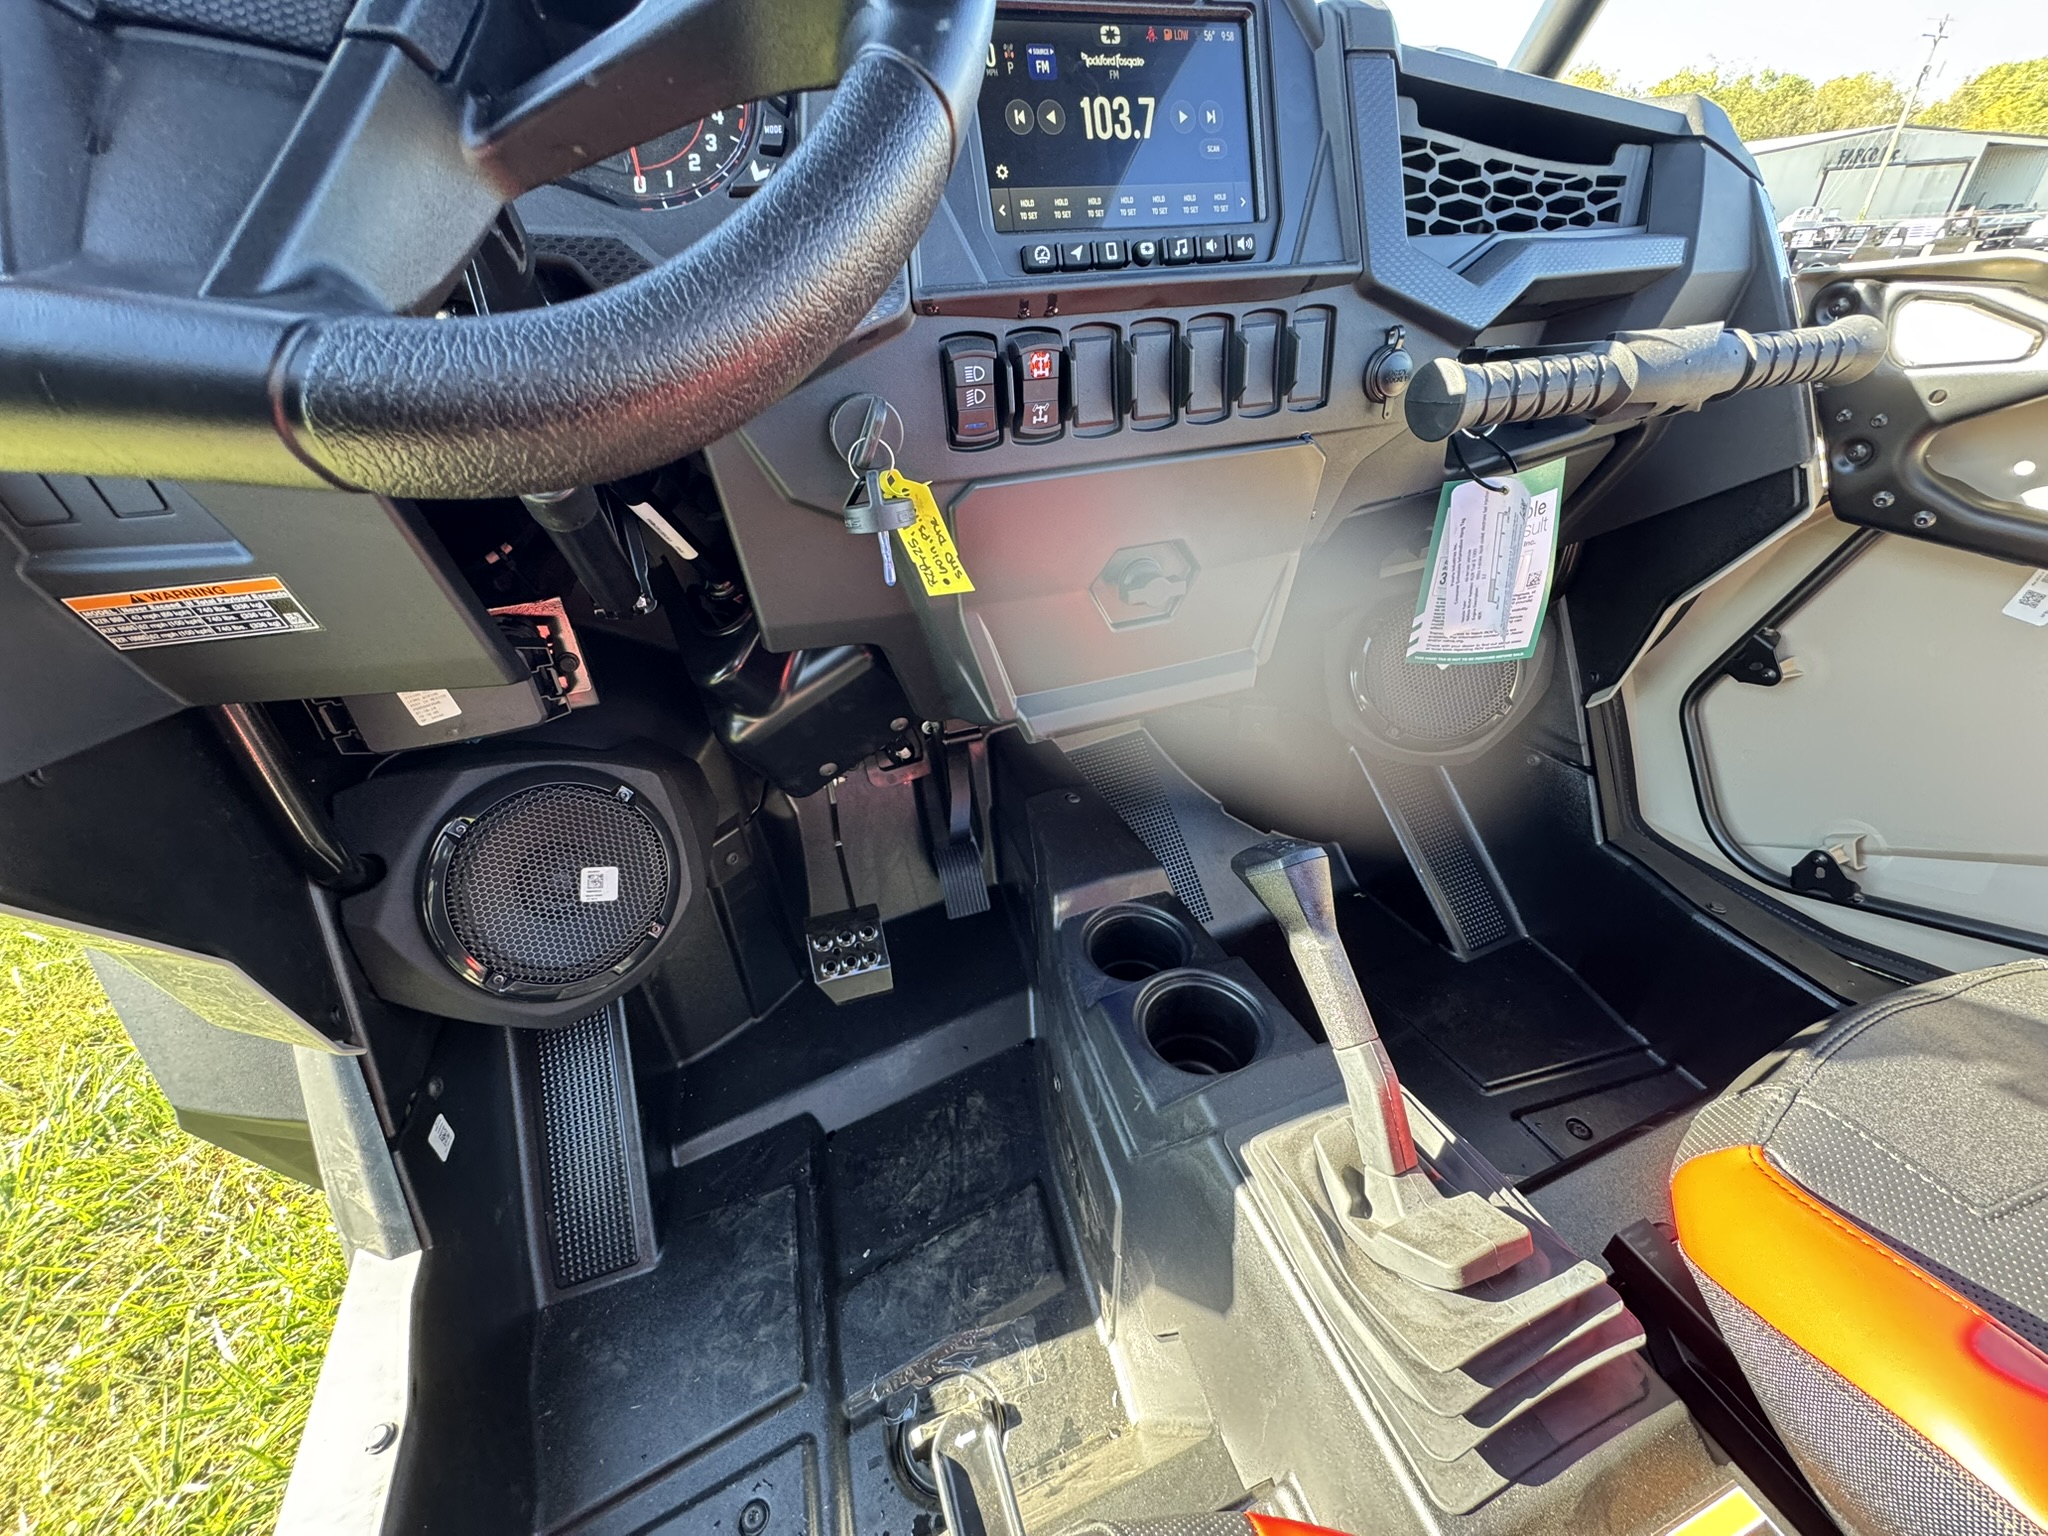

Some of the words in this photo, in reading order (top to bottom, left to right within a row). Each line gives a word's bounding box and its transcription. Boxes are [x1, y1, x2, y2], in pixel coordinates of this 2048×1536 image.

[1174, 30, 1188, 40] LOW
[1203, 30, 1215, 41] 56°
[1221, 31, 1234, 41] 9:58
[1007, 61, 1014, 75] P
[1036, 60, 1050, 74] FM
[986, 69, 998, 77] MPH
[1109, 69, 1120, 80] FM
[712, 111, 724, 125] 4
[1080, 96, 1155, 140] 103.7
[764, 125, 783, 134] MODE
[705, 134, 717, 152] 3
[1206, 145, 1220, 153] SCAN
[688, 153, 701, 172] 2
[666, 170, 673, 188] 1
[633, 175, 646, 194] 0
[1054, 198, 1068, 206] HOLD
[1087, 197, 1102, 205] HOLD
[1121, 196, 1134, 204] HOLD
[1152, 195, 1165, 203] HOLD
[1184, 194, 1196, 202] HOLD
[1020, 199, 1035, 208] HOLD
[1054, 211, 1061, 219] TO
[1062, 210, 1071, 218] SET
[1094, 209, 1104, 217] SET
[1127, 208, 1136, 216] SET
[1159, 207, 1168, 215] SET
[1183, 206, 1189, 214] TO
[1020, 212, 1027, 220] TO
[144, 586, 227, 601] WARNING
[82, 608, 117, 617] MODEL
[148, 602, 181, 610] Exceed
[216, 595, 250, 604] Payload
